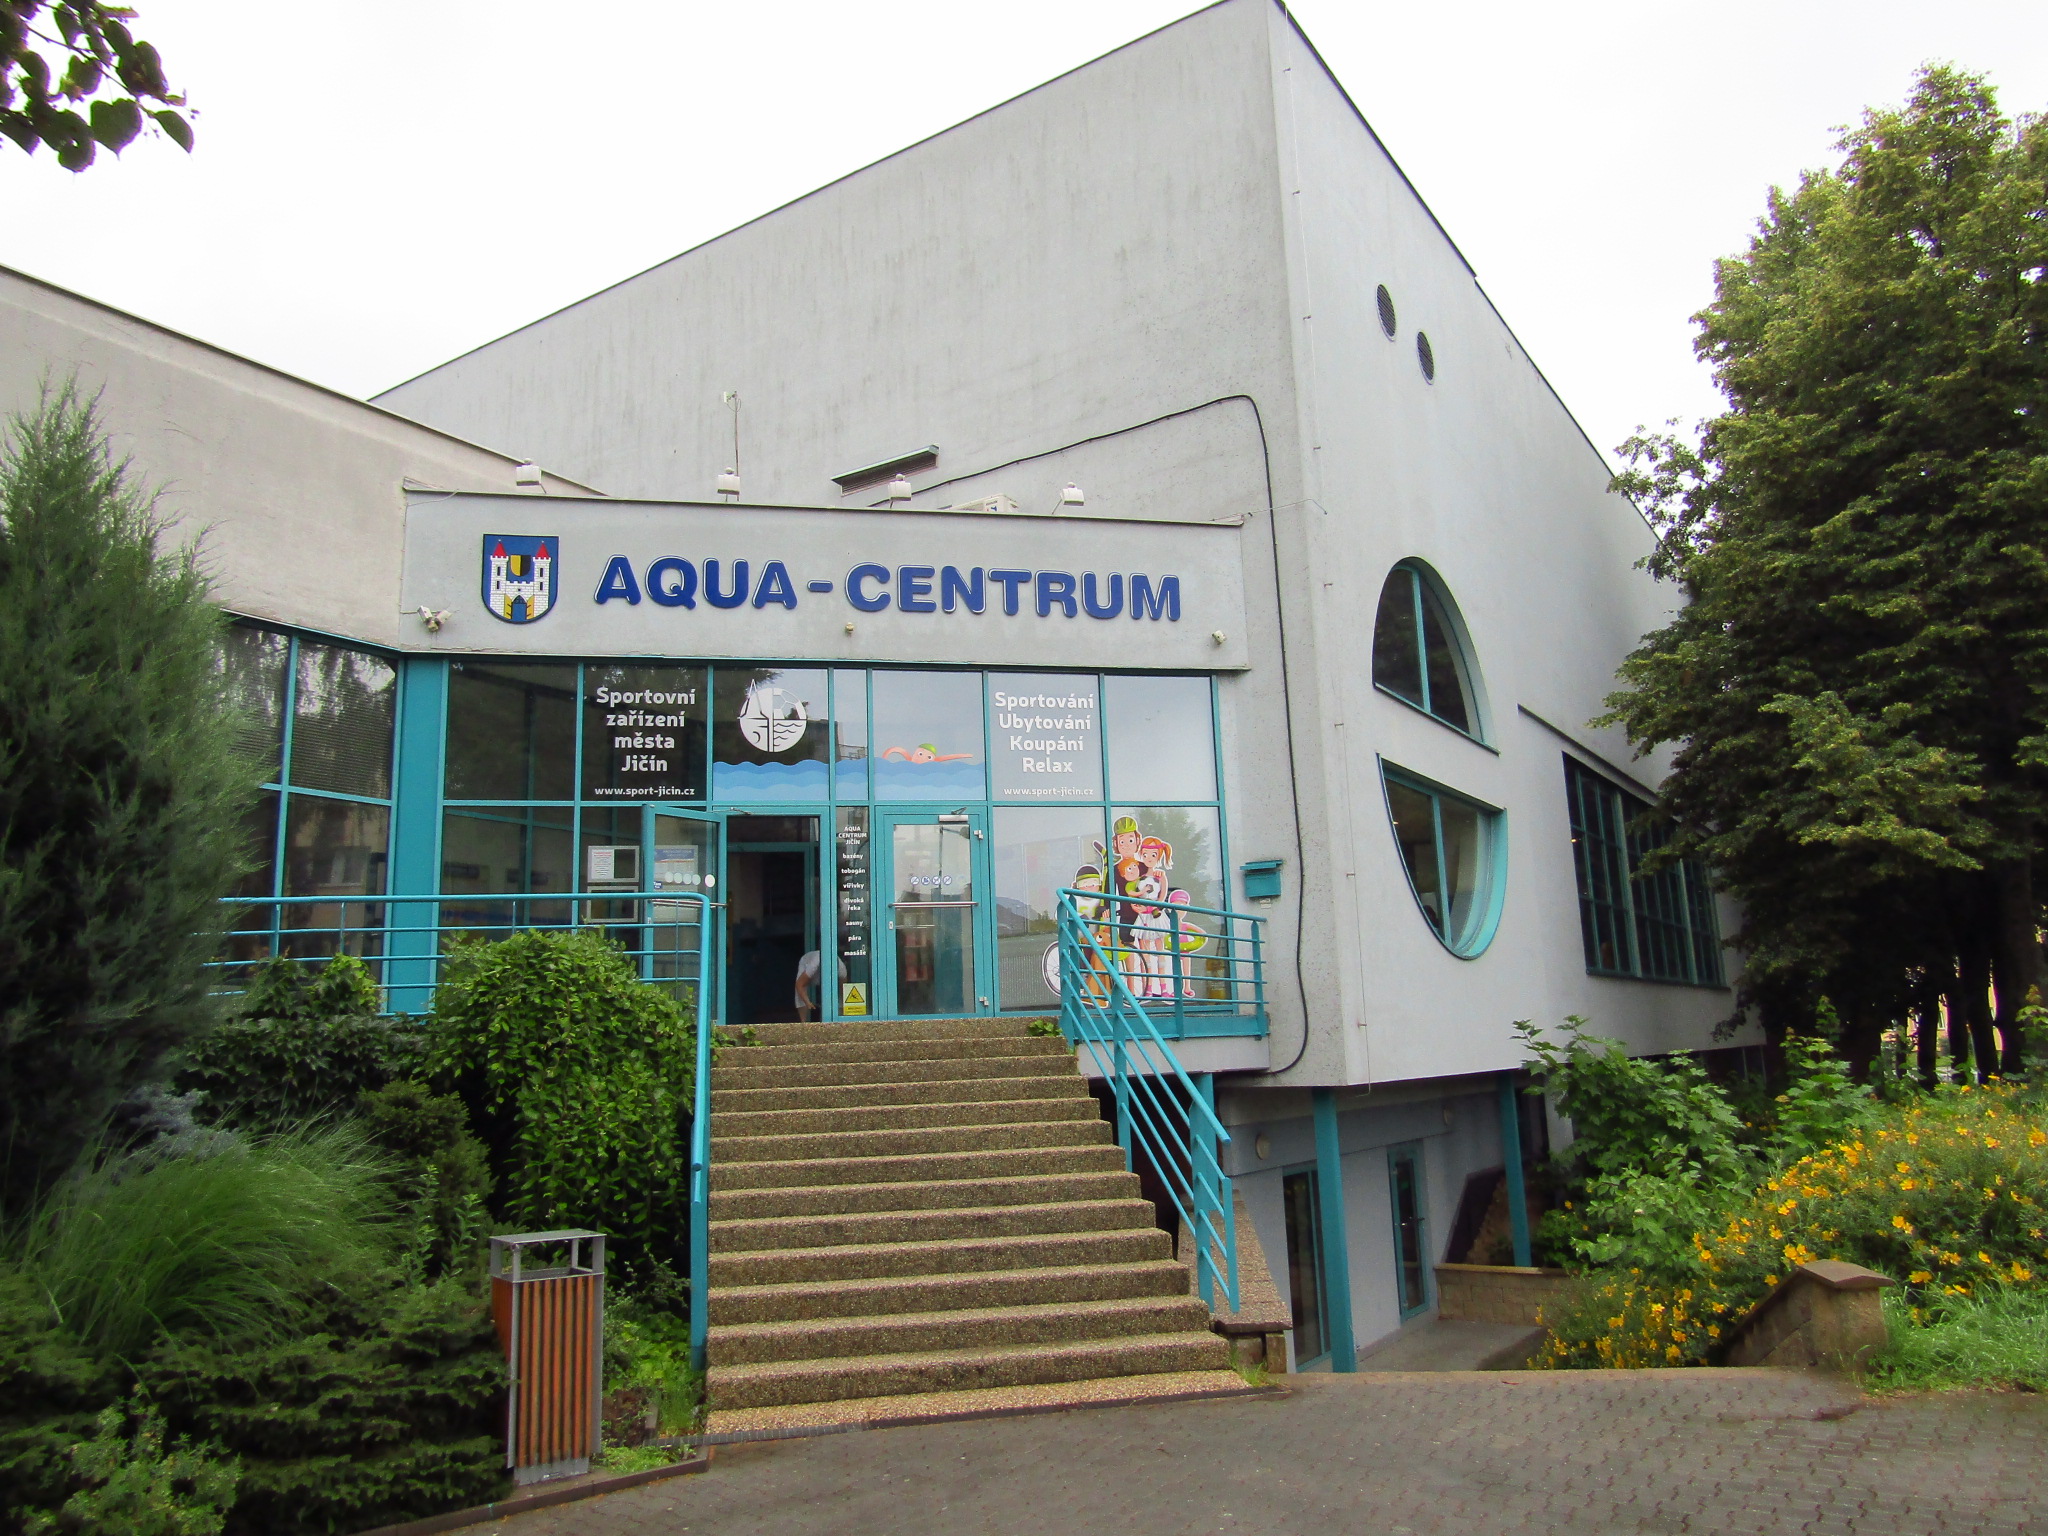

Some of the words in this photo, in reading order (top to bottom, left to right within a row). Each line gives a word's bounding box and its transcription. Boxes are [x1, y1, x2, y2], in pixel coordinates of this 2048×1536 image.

[596, 686, 696, 707] Sportovní
[995, 691, 1094, 712] Sportování
[606, 709, 685, 727] zařízení
[999, 713, 1091, 733] Ubytování
[614, 732, 675, 749] města
[1009, 735, 1084, 755] Koupání
[621, 754, 668, 772] Jičín
[1022, 757, 1073, 774] Relax
[594, 786, 695, 797] www.sport-jicin.cz
[1003, 785, 1094, 797] www.sport-jicin.cz
[841, 867, 866, 875] tobogán
[843, 882, 865, 890] vířivky
[844, 896, 865, 904] divoká
[848, 934, 862, 942] pára
